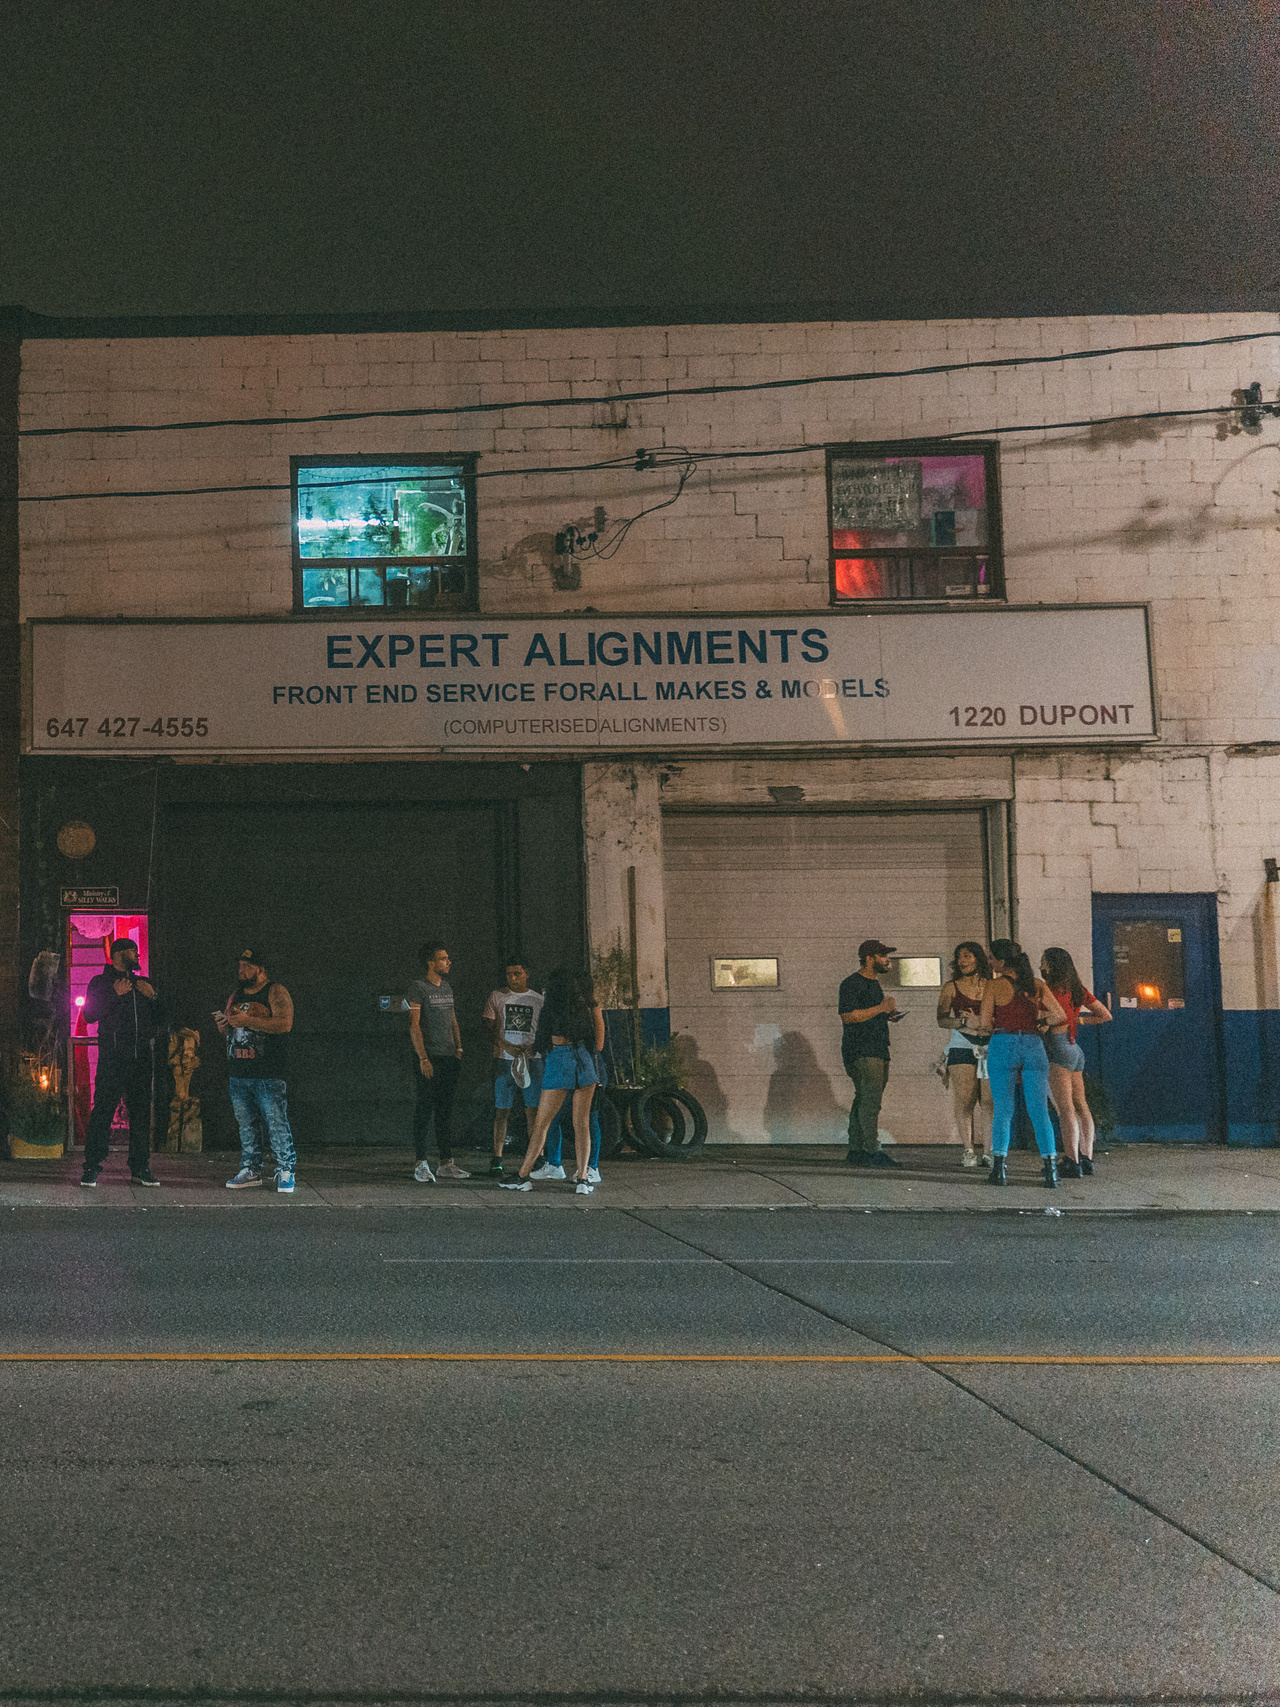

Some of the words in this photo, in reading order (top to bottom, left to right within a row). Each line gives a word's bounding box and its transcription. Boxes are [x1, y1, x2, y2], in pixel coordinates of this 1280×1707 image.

[327, 633, 509, 668] EXPERT
[523, 629, 829, 666] ALIGNMENTS
[273, 684, 358, 704] FRONT
[366, 684, 418, 703] END
[426, 683, 535, 703] SERVICE
[656, 680, 747, 700] MAKES
[756, 679, 772, 699] &
[46, 717, 89, 737] 647
[97, 717, 209, 737] 427-4555
[949, 706, 1006, 727] 1220
[1020, 704, 1134, 725] DUPONT
